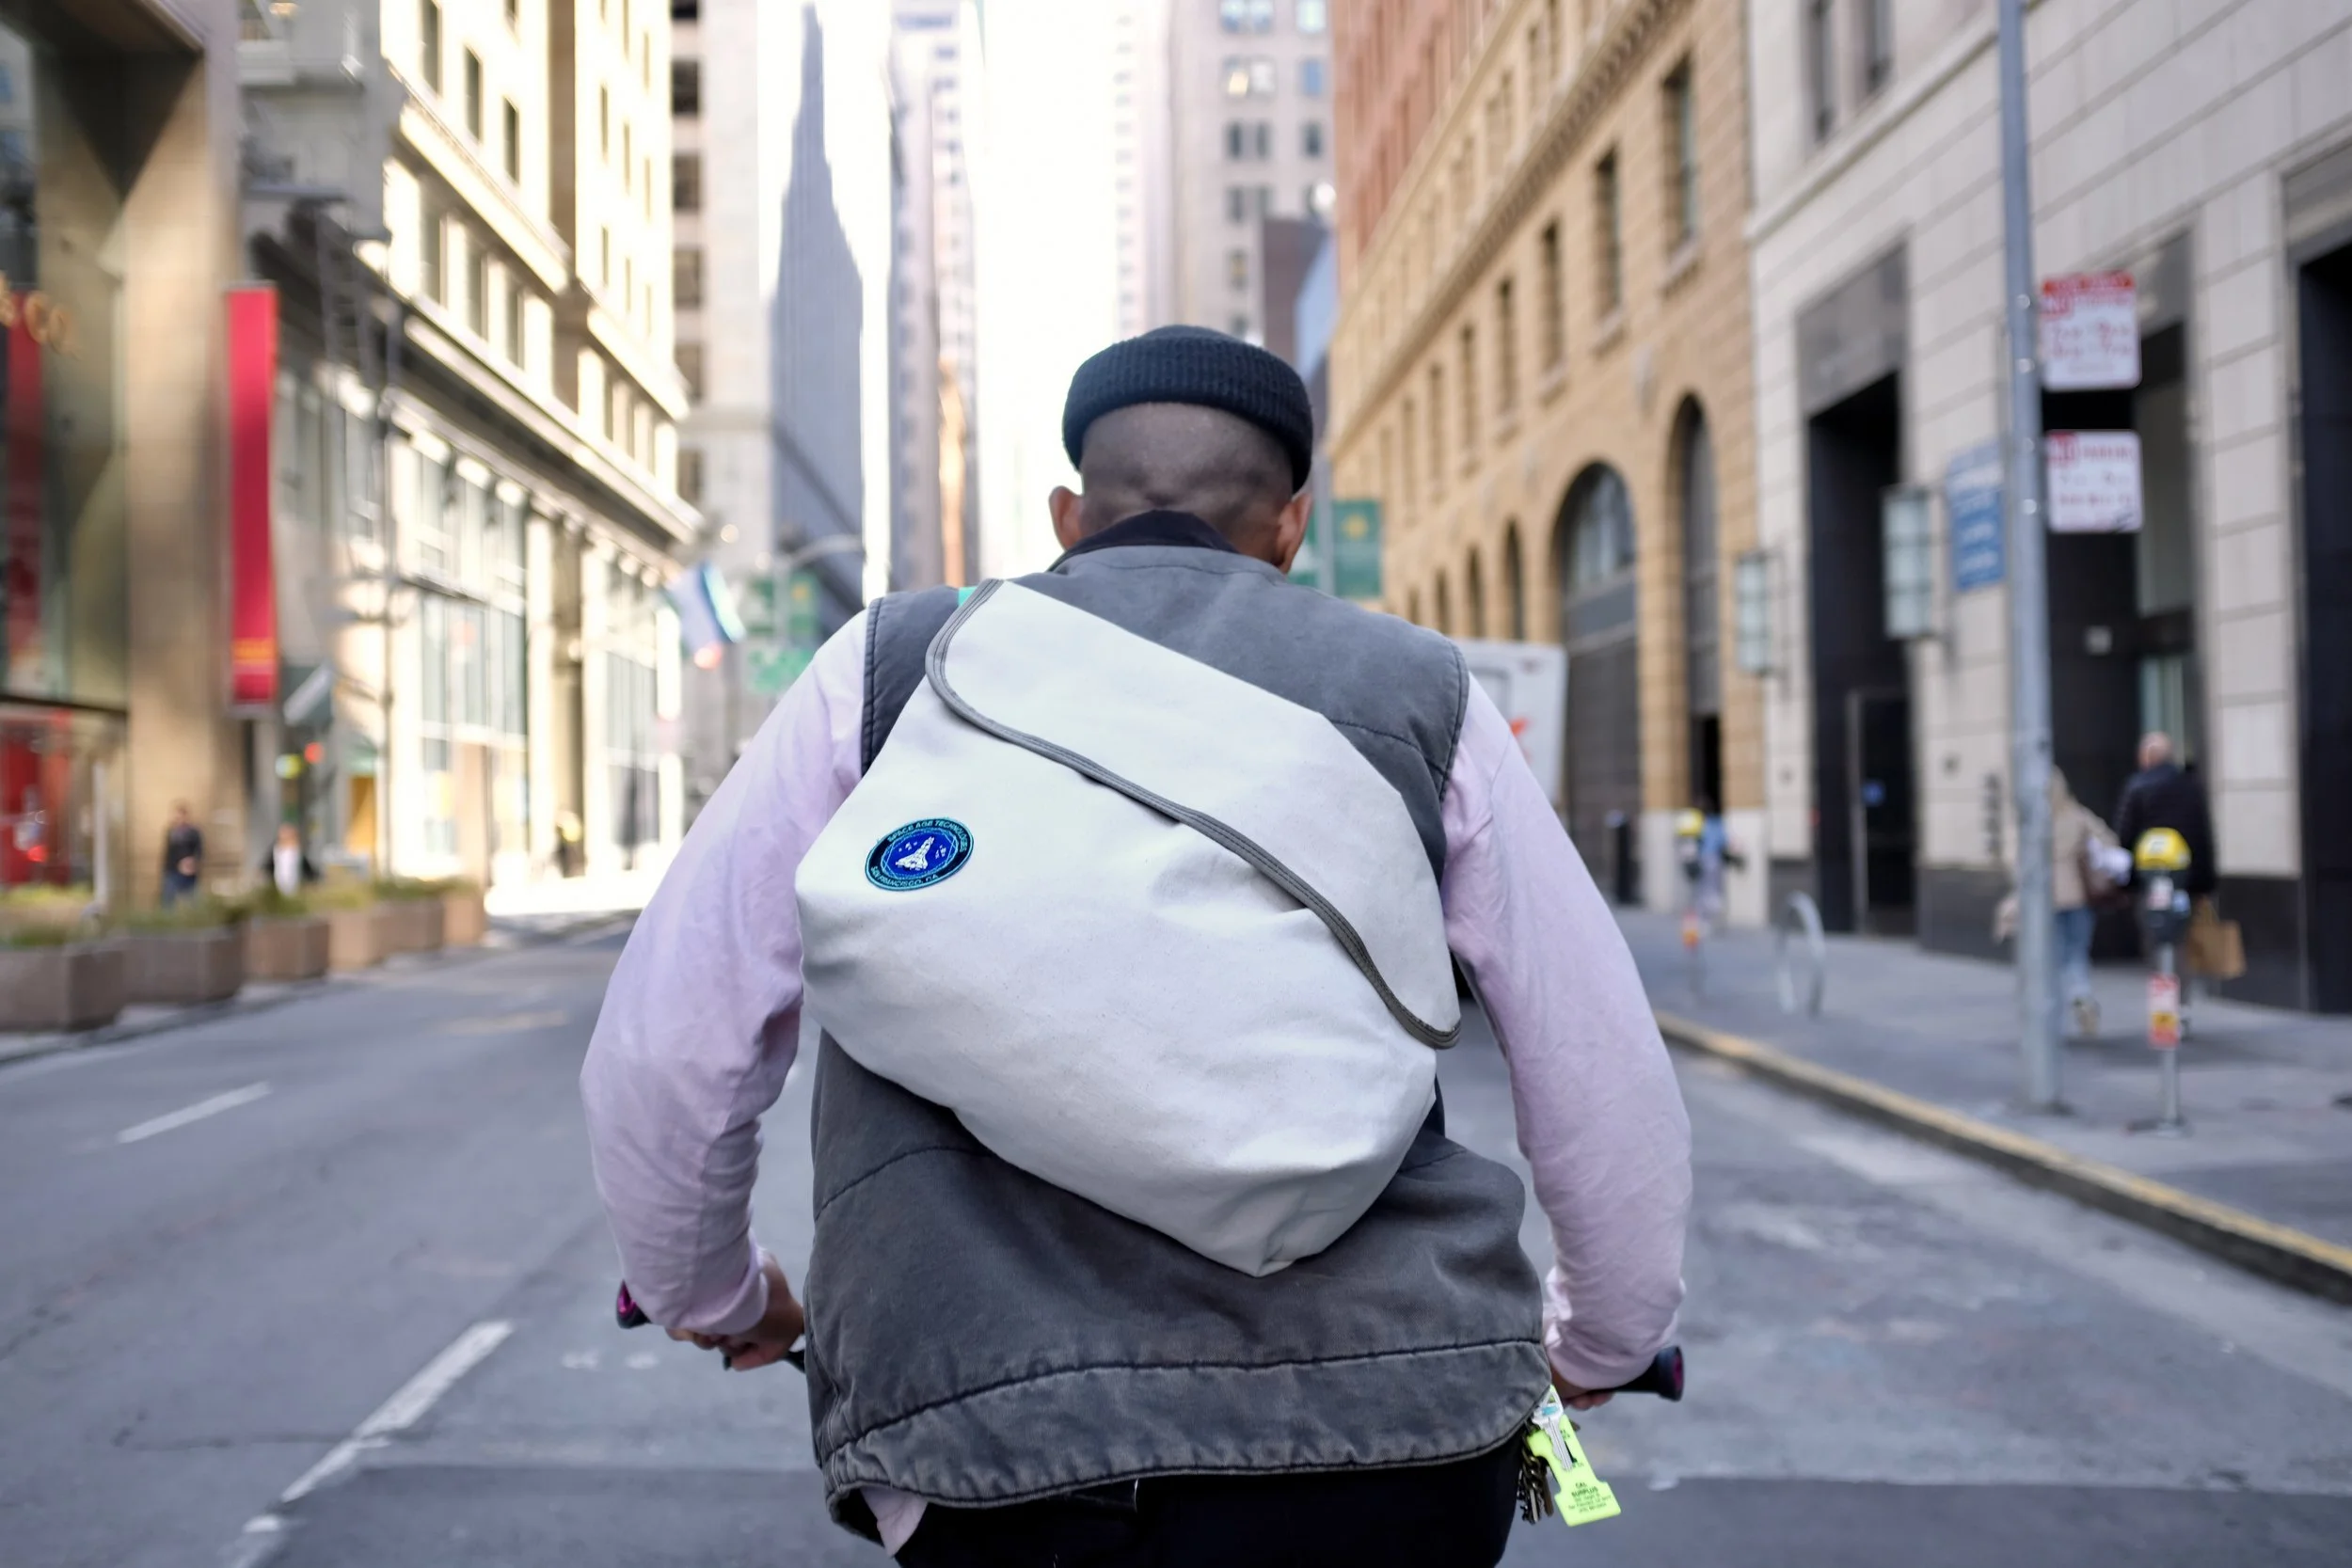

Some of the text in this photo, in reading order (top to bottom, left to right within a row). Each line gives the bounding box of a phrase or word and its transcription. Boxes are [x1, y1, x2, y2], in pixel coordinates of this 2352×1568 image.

[887, 827, 914, 842] SPACE
[915, 820, 933, 829] AGE
[925, 874, 939, 882] CA
[1571, 1485, 1598, 1497] SURPLUS
